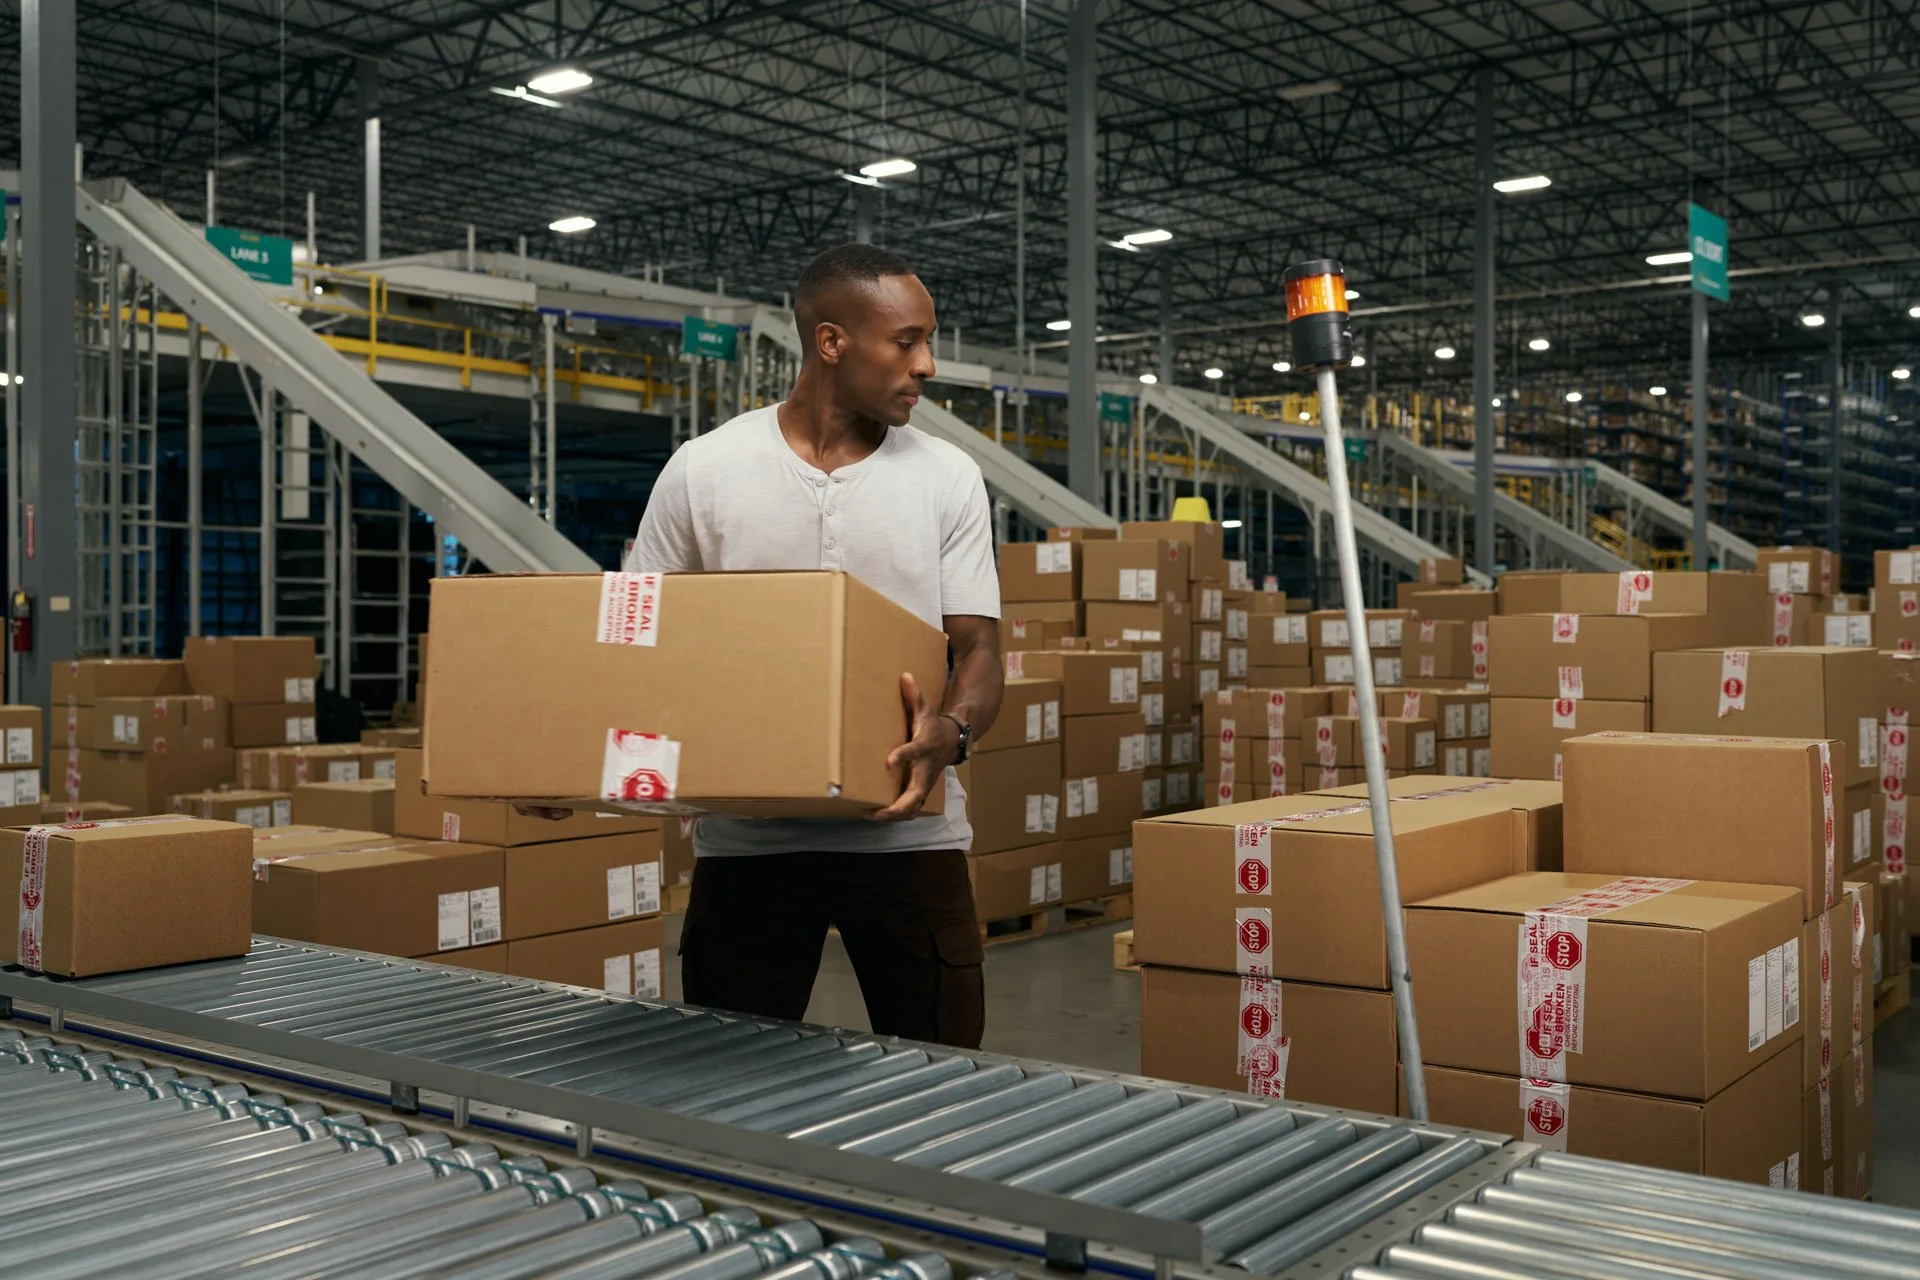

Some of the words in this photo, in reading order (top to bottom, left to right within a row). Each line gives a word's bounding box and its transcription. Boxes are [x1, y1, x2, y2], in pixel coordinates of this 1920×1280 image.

[639, 595, 654, 635] SEAL
[1248, 862, 1259, 890] STOP
[1249, 922, 1260, 949] STOP
[1529, 923, 1538, 954] SEAL
[1530, 957, 1539, 968] IF
[1557, 935, 1570, 966] STOP
[1544, 991, 1553, 1022] SEAL
[1555, 983, 1565, 1032] BROKEN
[1251, 1007, 1263, 1035] STOP
[1544, 1025, 1552, 1036] IF
[1554, 1036, 1563, 1047] IS
